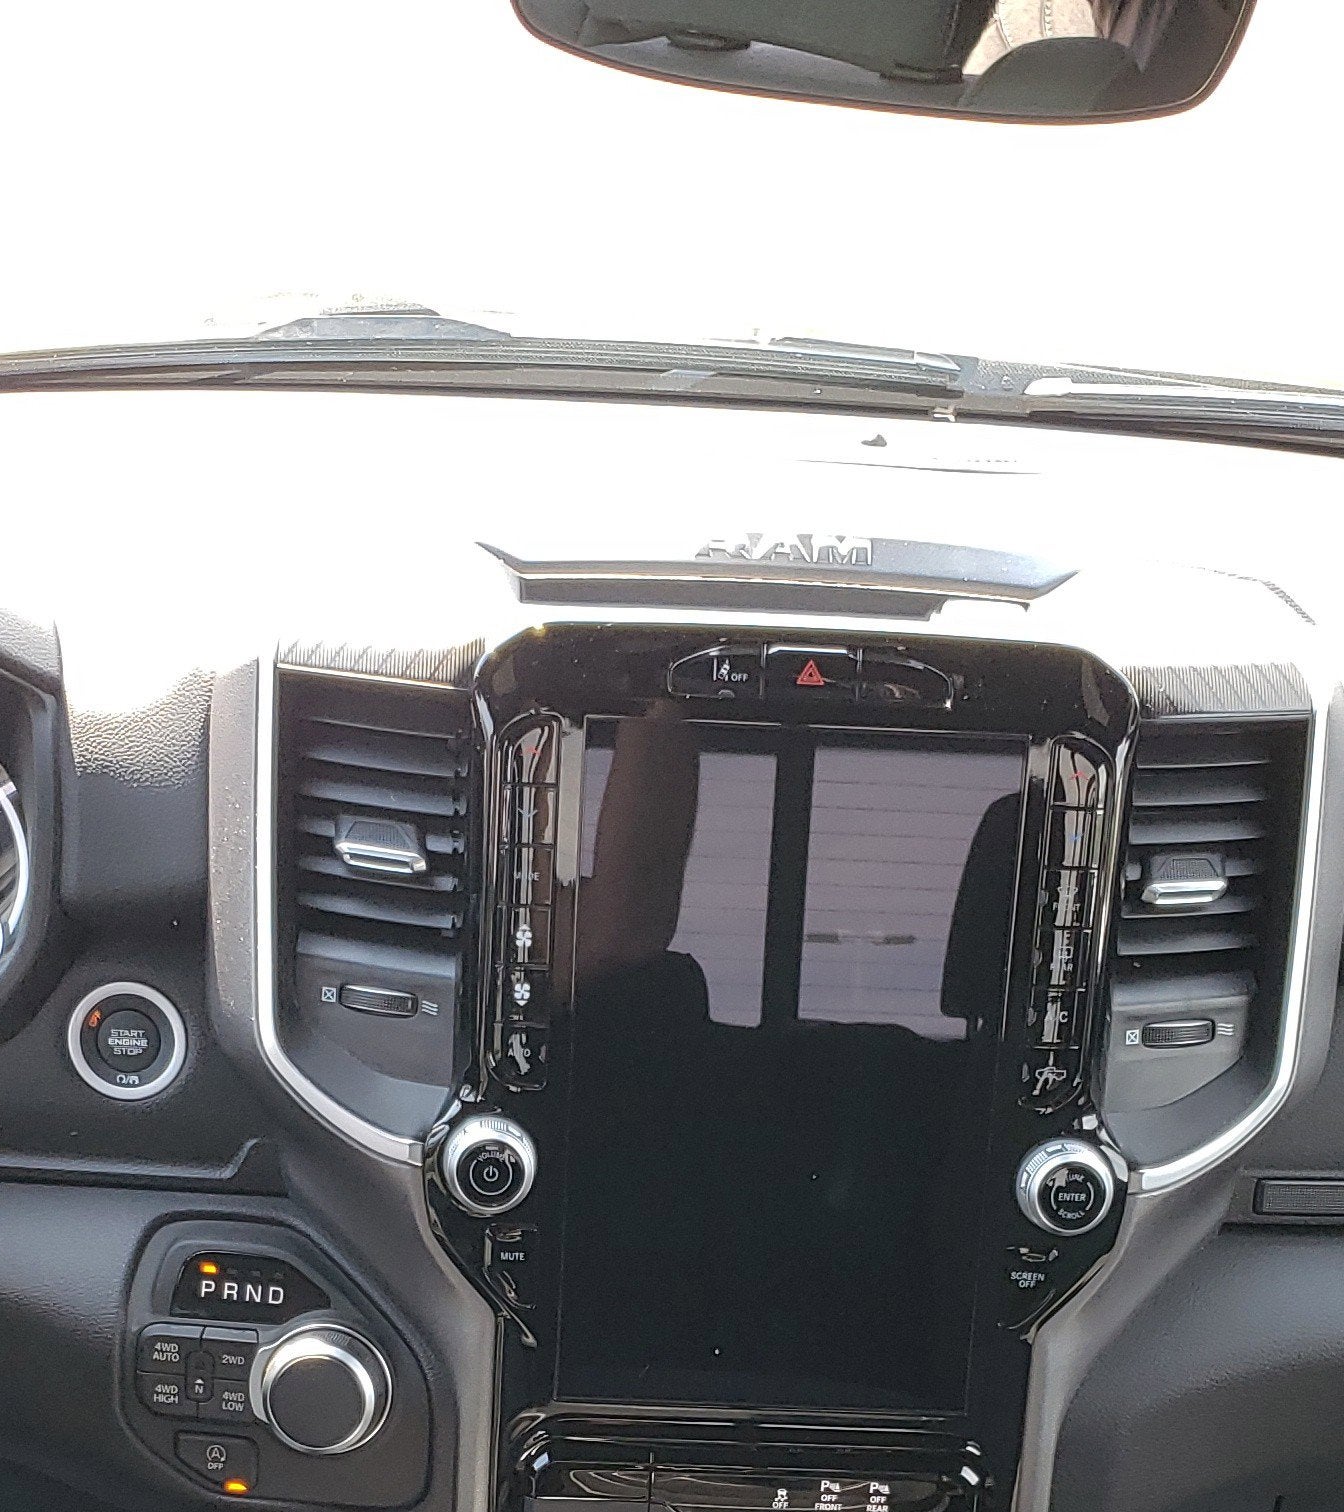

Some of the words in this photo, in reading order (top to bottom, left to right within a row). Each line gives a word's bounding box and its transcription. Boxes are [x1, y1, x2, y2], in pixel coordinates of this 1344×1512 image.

[695, 533, 872, 566] RAM
[731, 672, 749, 682] OFF
[110, 1029, 145, 1037] START
[108, 1038, 148, 1047] ENGINE
[113, 1047, 143, 1055] STOP
[1058, 1192, 1087, 1202] ENTER
[1057, 1208, 1086, 1220] SCROLL
[501, 1252, 525, 1261] MUTE
[1011, 1271, 1045, 1281] SCREEN
[1018, 1280, 1036, 1288] OFF
[154, 1342, 179, 1353] 4WD
[152, 1352, 180, 1362] AUTO
[222, 1355, 245, 1365] 2WD
[154, 1385, 179, 1394] 4WD
[194, 1385, 204, 1394] N
[153, 1394, 179, 1404] HIGH
[222, 1391, 245, 1402] 4WD
[222, 1402, 244, 1412] LOW
[207, 1462, 224, 1470] OFF
[820, 1494, 838, 1502] OFF
[869, 1496, 887, 1504] OFF
[814, 1503, 843, 1511] FRONT
[866, 1505, 889, 1512] REAR
